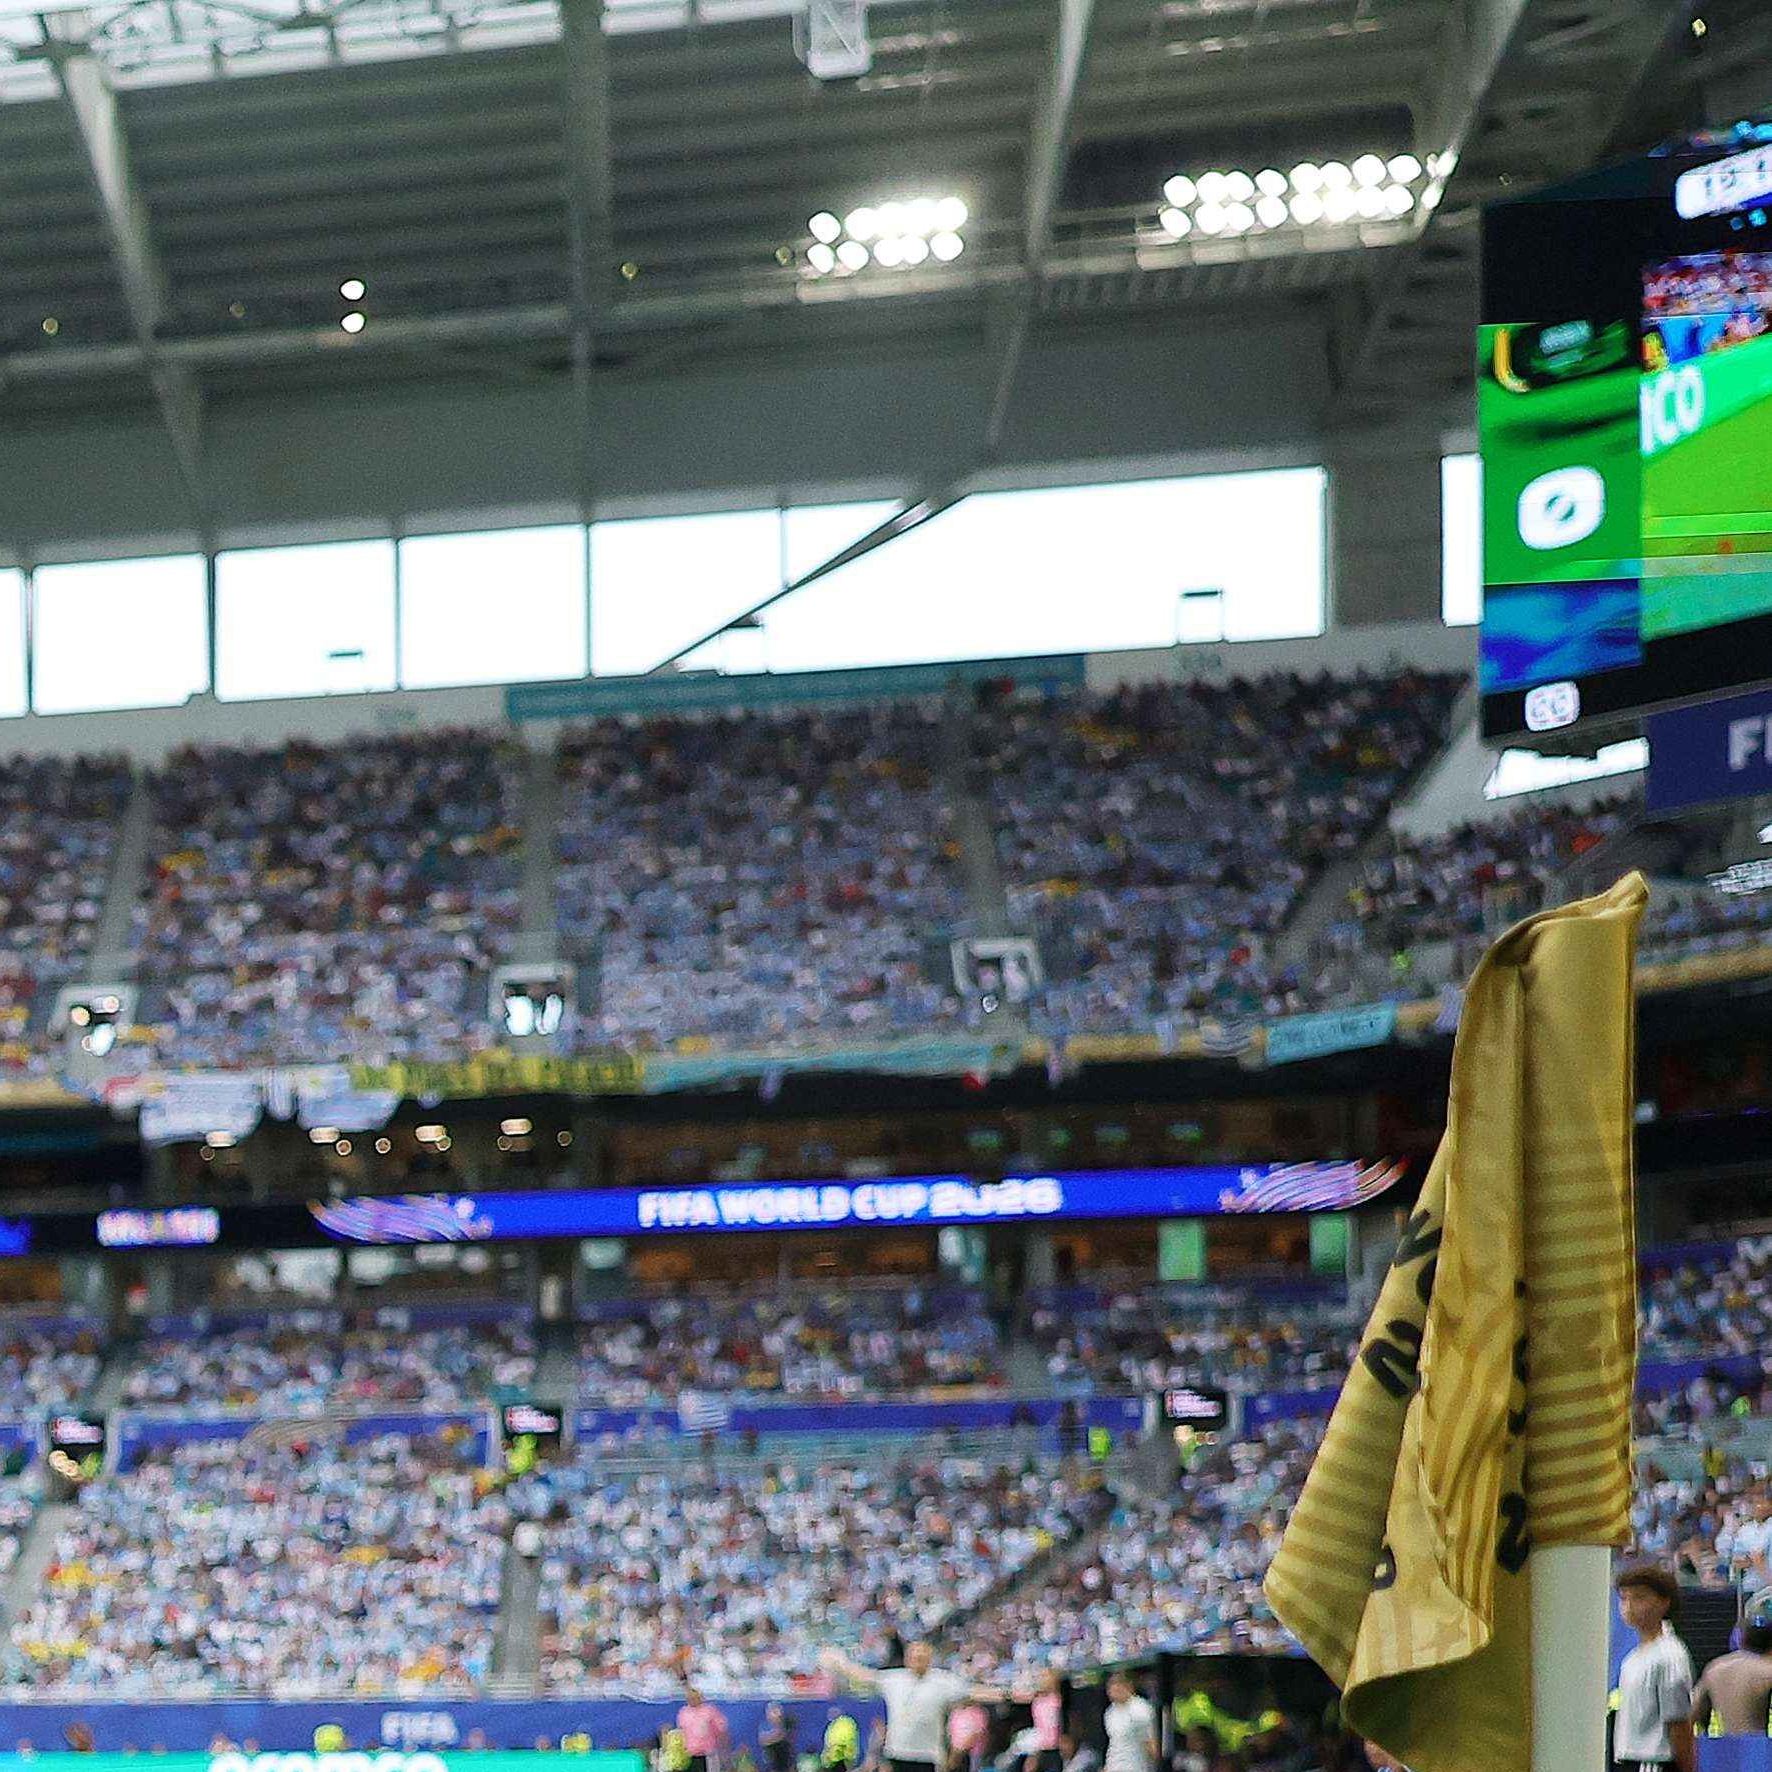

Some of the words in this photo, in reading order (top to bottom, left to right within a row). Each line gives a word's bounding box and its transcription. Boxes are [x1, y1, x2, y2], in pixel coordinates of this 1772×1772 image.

[637, 1190, 719, 1228] FIFA
[718, 1184, 851, 1224] WORLD
[851, 1182, 929, 1220] CUP
